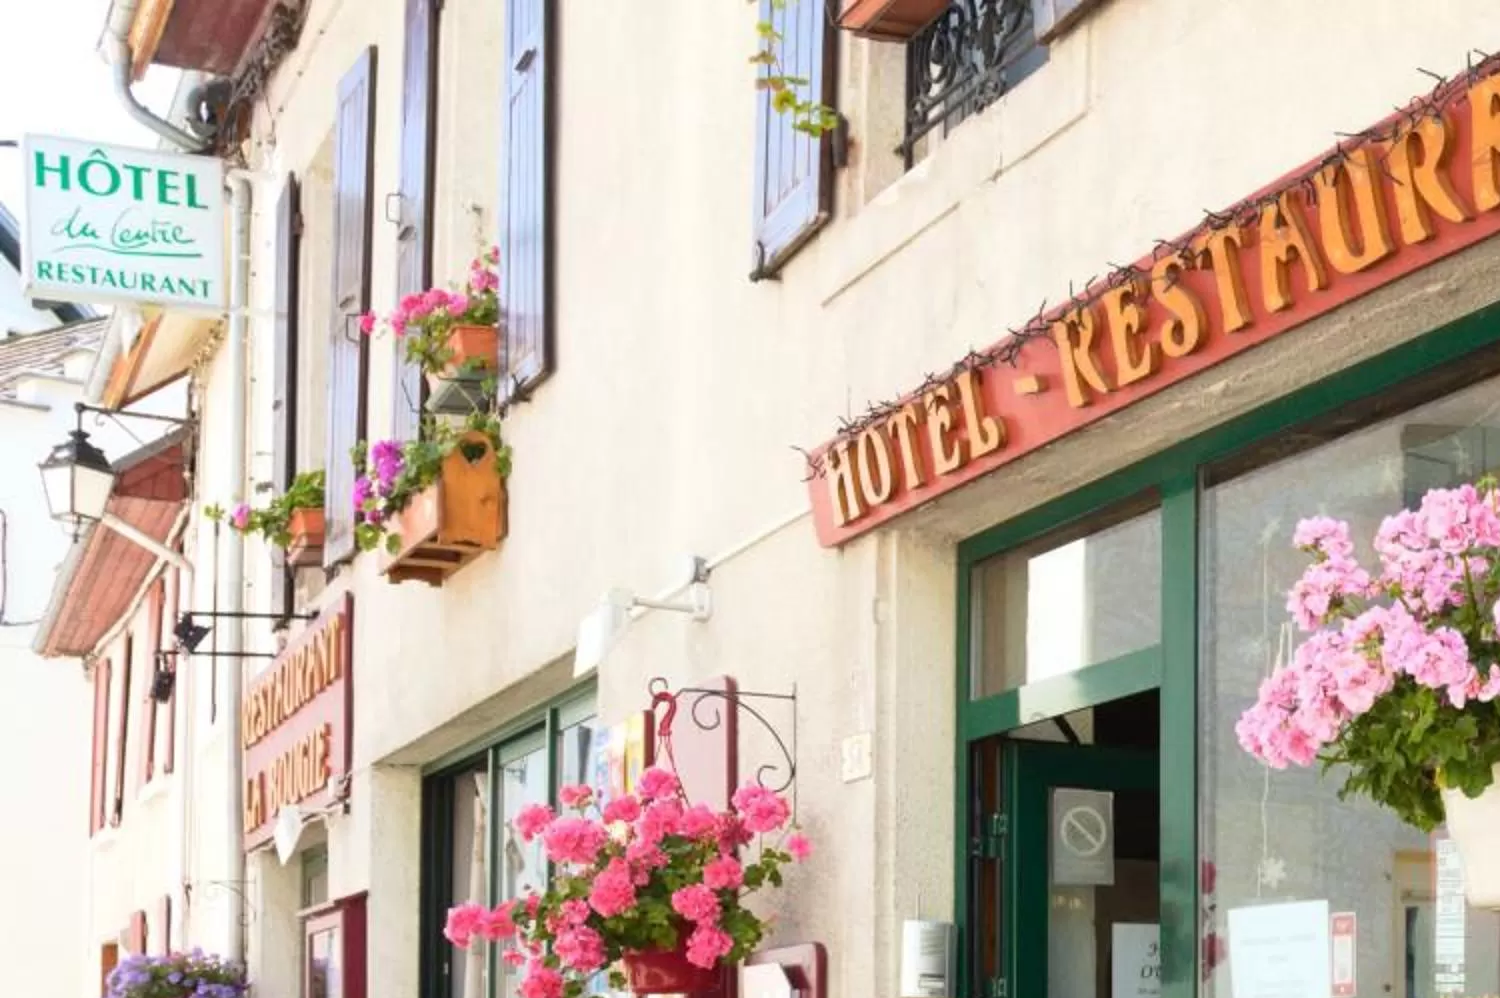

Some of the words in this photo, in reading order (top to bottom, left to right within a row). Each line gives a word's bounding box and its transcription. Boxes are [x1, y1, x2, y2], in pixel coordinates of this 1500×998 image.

[35, 148, 209, 210] HÔTEL
[50, 204, 101, 240] du
[111, 206, 196, 249] Centre
[36, 260, 212, 299] RESTAURANT
[824, 369, 1006, 528] HOTEL
[241, 613, 344, 750] RESTAURANT
